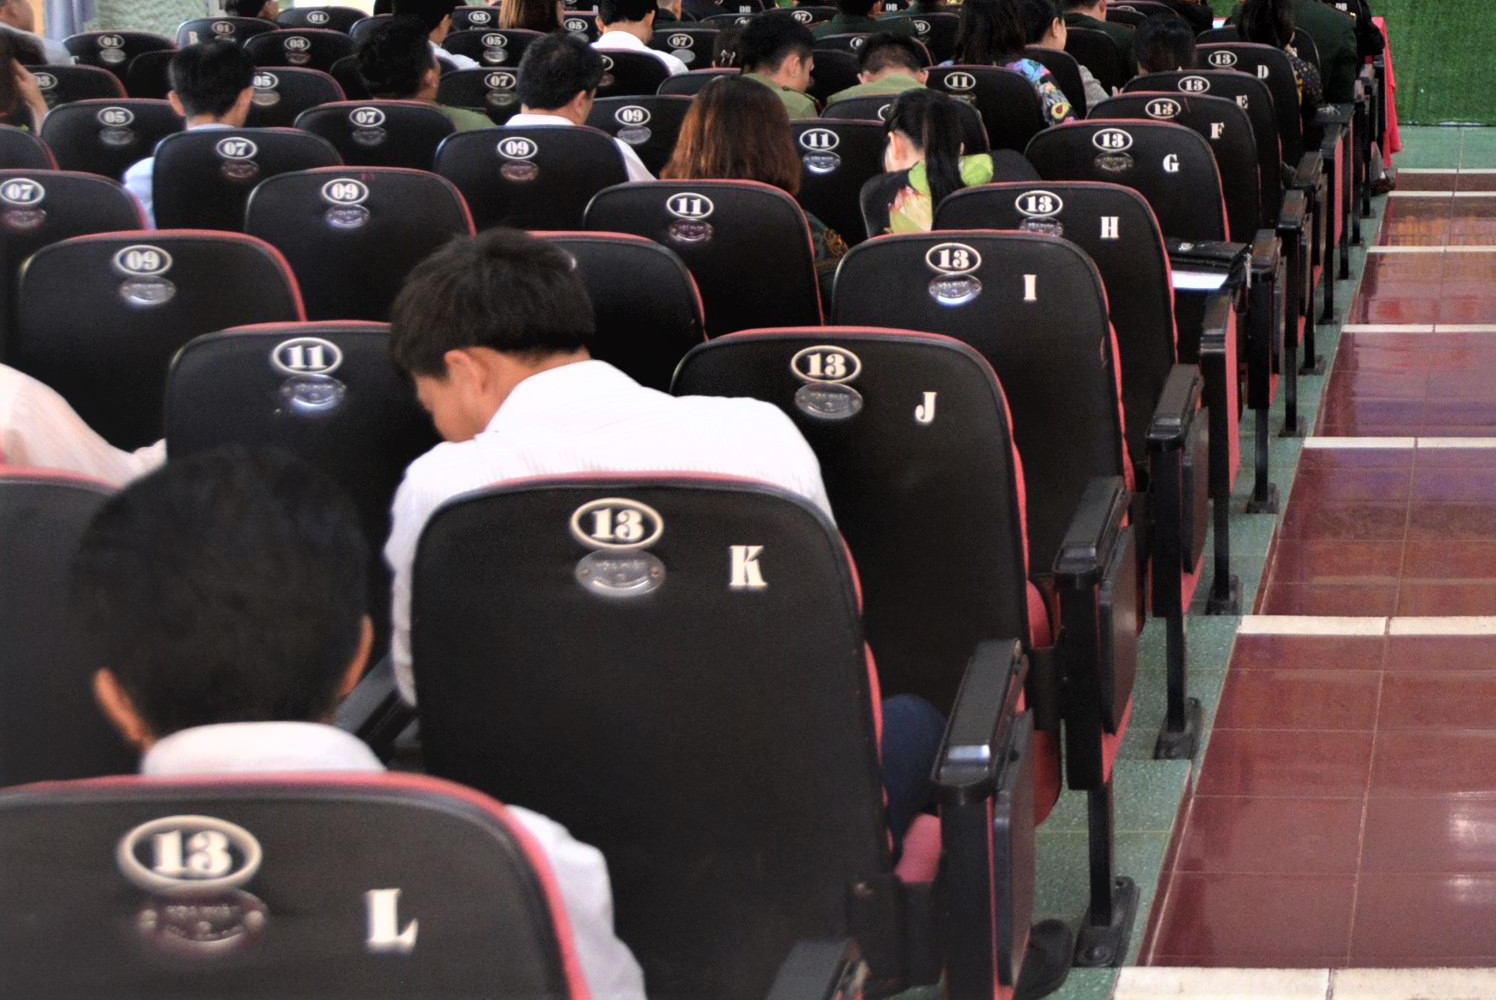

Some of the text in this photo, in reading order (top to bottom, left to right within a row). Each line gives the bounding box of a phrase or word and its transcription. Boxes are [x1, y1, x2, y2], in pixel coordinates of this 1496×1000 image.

[808, 133, 831, 148] 11
[1102, 132, 1124, 148] 13
[1210, 122, 1226, 140] F
[506, 141, 530, 156] 09
[1162, 153, 1180, 173] G
[8, 183, 33, 200] 07
[332, 183, 358, 200] 09
[677, 198, 702, 215] 11
[1027, 196, 1052, 214] 13
[1101, 216, 1119, 239] H
[126, 250, 161, 272] 09
[937, 248, 970, 270] 13
[1023, 274, 1038, 301] I
[285, 344, 328, 370] 11
[806, 352, 847, 378] 13
[914, 391, 938, 424] J
[591, 507, 645, 542] 13
[729, 545, 769, 588] K
[152, 829, 233, 879] 13
[365, 888, 419, 954] L
